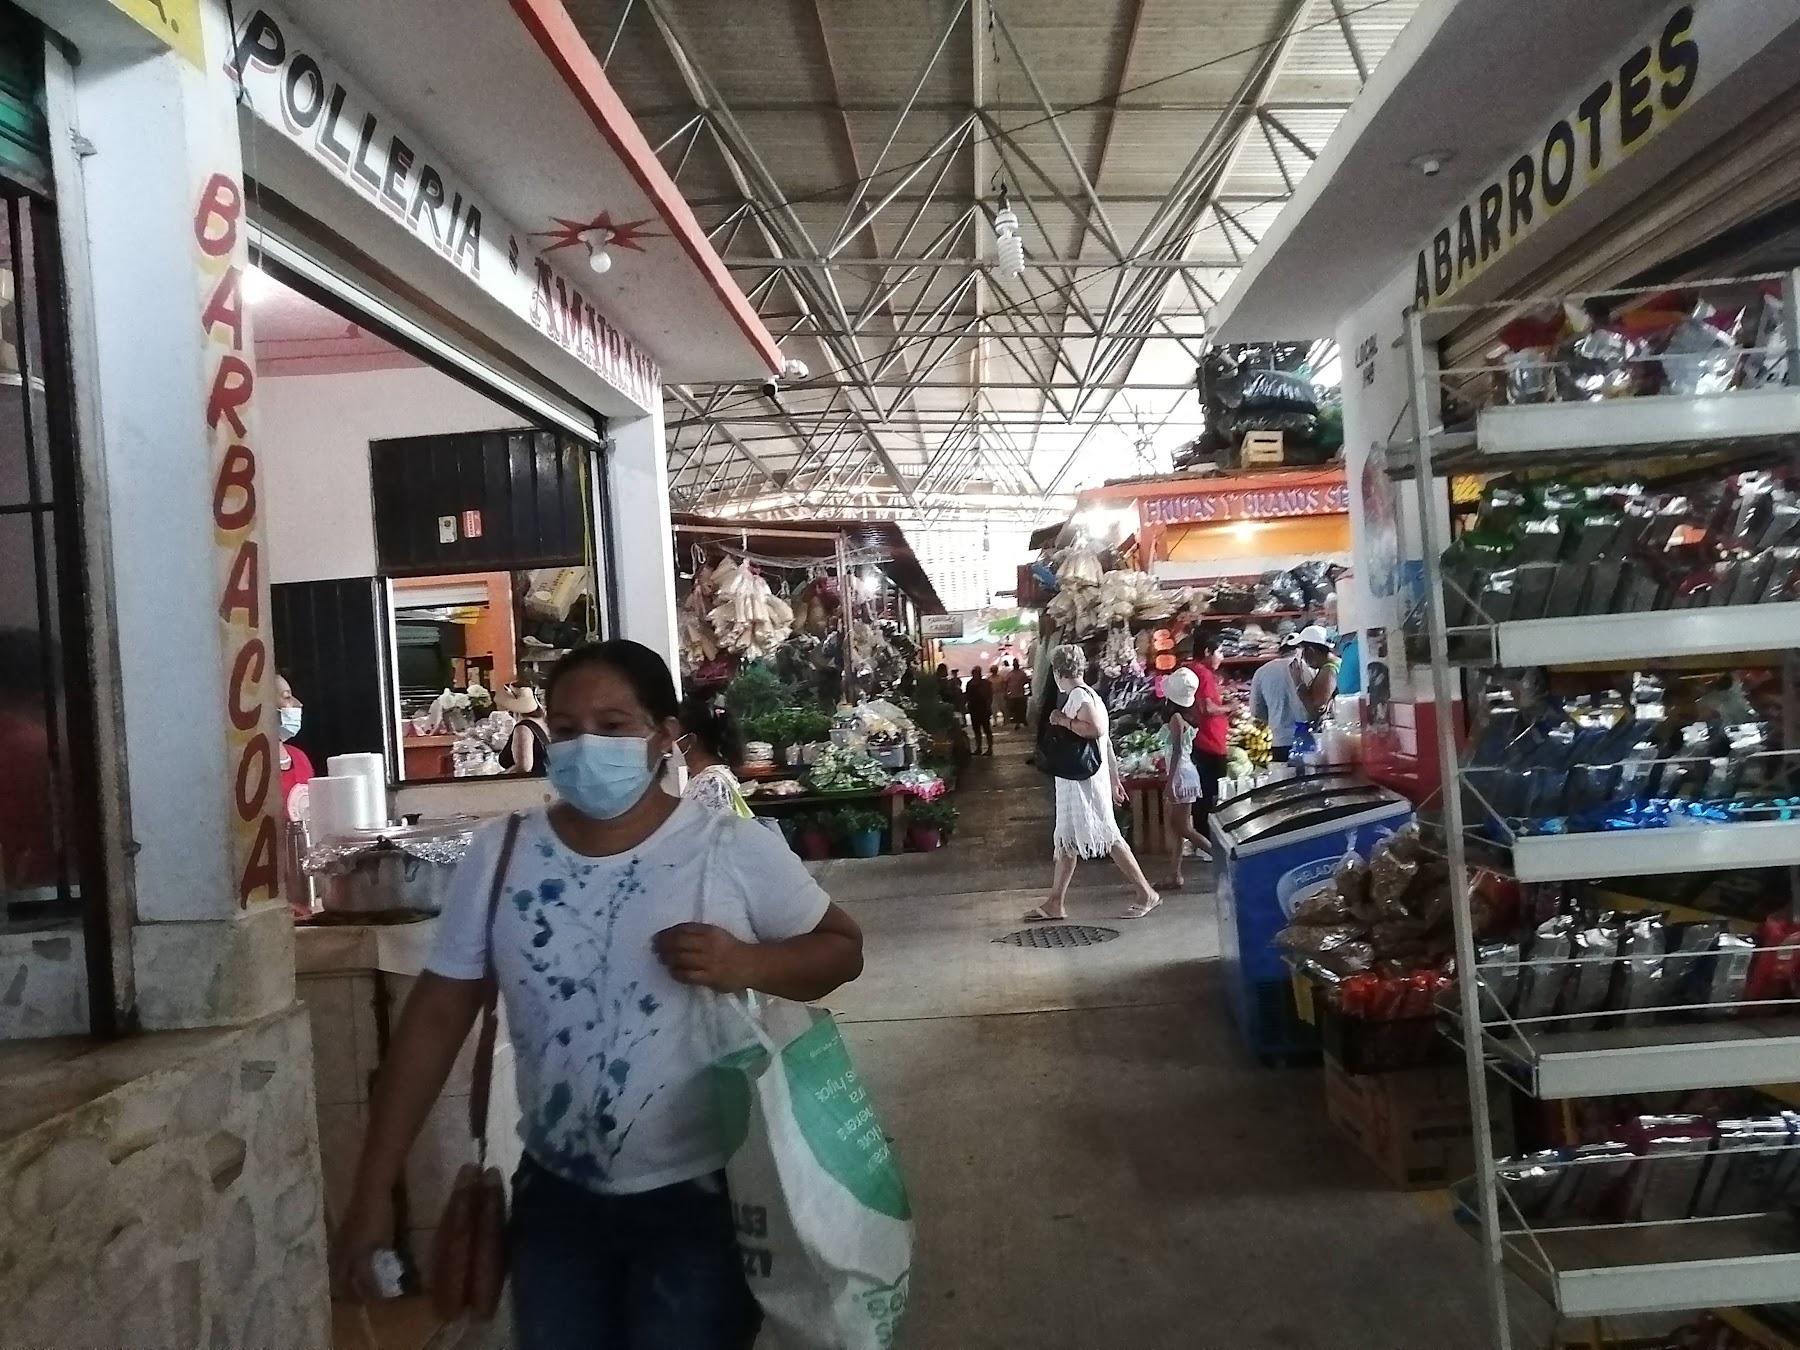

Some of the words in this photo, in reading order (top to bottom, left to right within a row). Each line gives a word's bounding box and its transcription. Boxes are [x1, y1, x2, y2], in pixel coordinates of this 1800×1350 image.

[223, 9, 482, 282] POLLERIA
[1412, 4, 1700, 314] ABARROTES
[194, 172, 280, 910] BARBACOA
